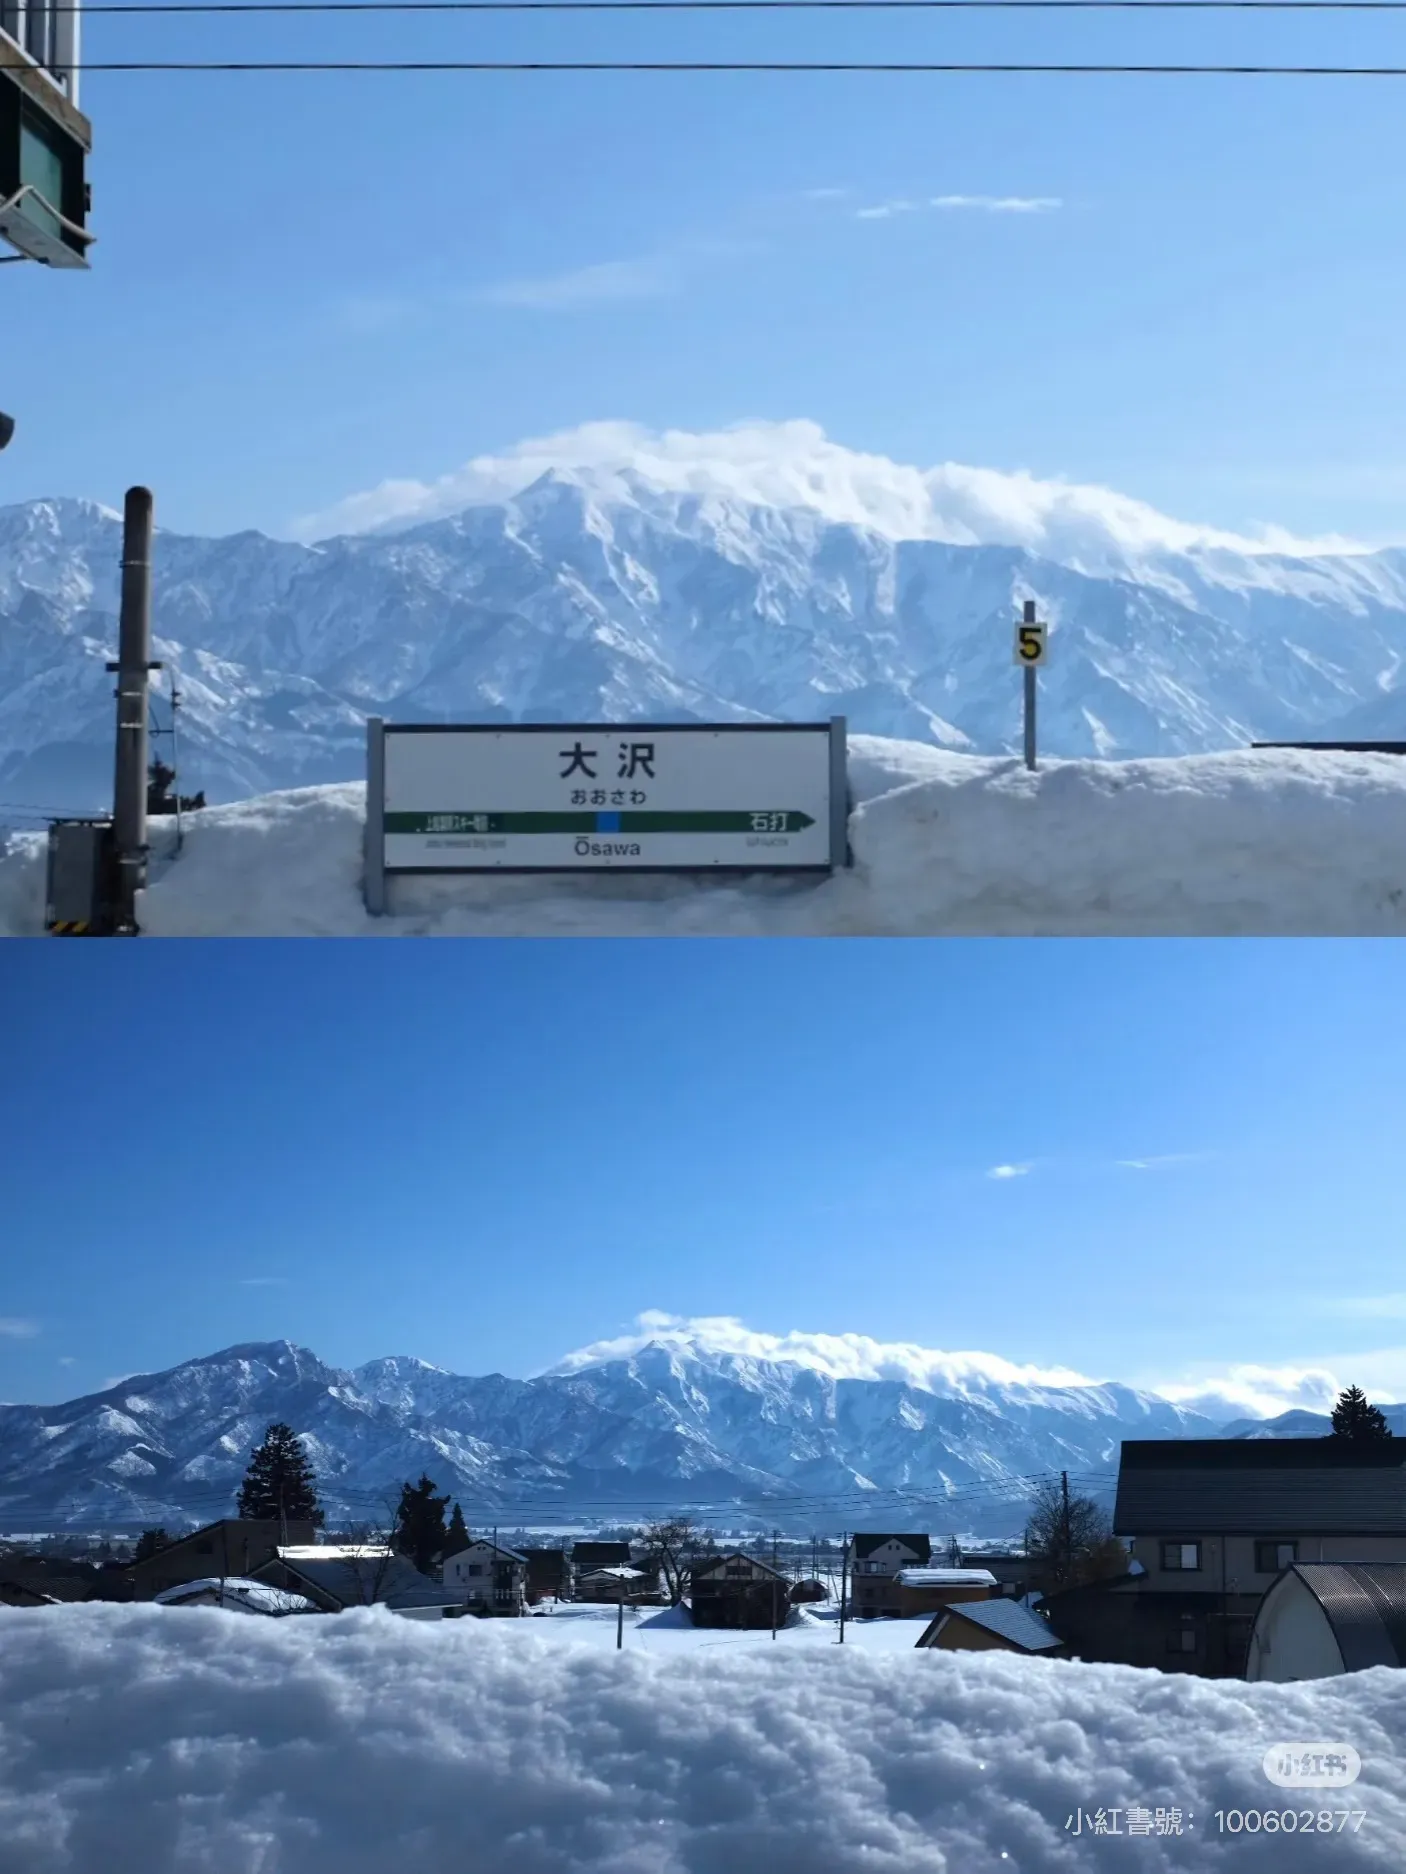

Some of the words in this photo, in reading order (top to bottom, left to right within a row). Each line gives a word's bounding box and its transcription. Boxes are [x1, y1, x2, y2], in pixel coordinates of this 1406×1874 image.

[1019, 627, 1042, 661] 5
[559, 742, 656, 779] 大沢
[570, 788, 647, 806] おおさわ
[749, 812, 789, 832] 石打
[574, 836, 642, 857] Ōsawa
